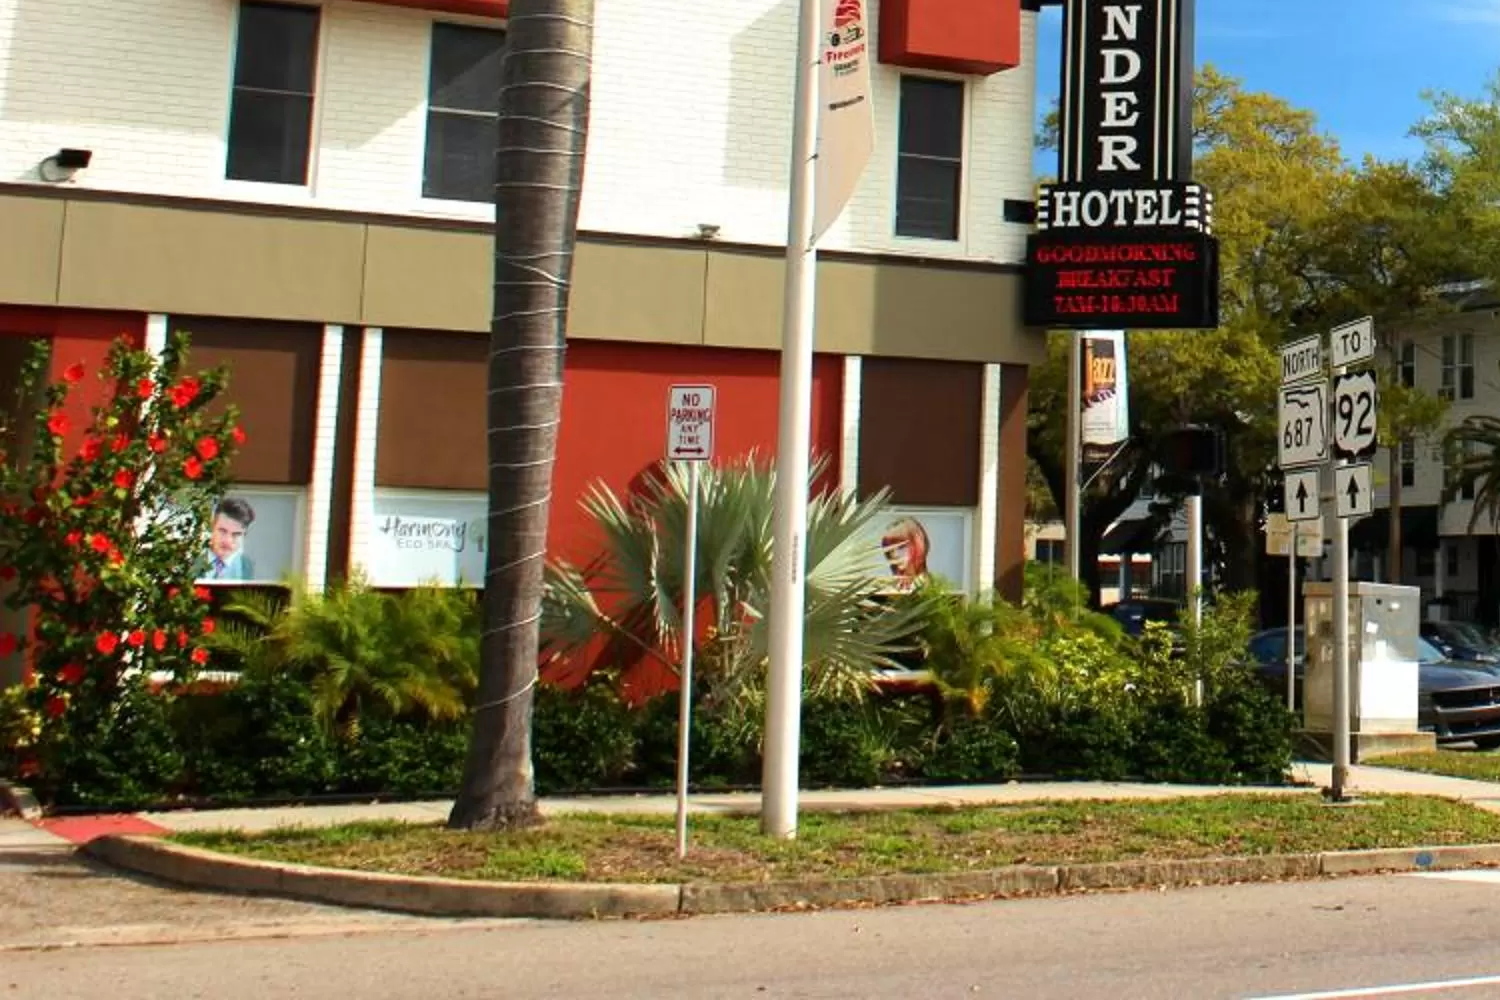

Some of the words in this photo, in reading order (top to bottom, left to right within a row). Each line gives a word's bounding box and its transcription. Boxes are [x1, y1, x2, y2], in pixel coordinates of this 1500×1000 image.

[1052, 188, 1181, 227] HOTEL
[1056, 268, 1176, 288] BREAKFAST
[1341, 331, 1361, 356] TO
[1283, 348, 1319, 377] NORTH
[681, 393, 701, 407] NO
[671, 407, 711, 421] PARKING
[1339, 391, 1373, 438] 92
[681, 424, 699, 433] ANY
[1283, 417, 1313, 449] 687
[679, 435, 699, 445] TIME
[379, 516, 467, 553] Harmony
[398, 539, 422, 549] ECO
